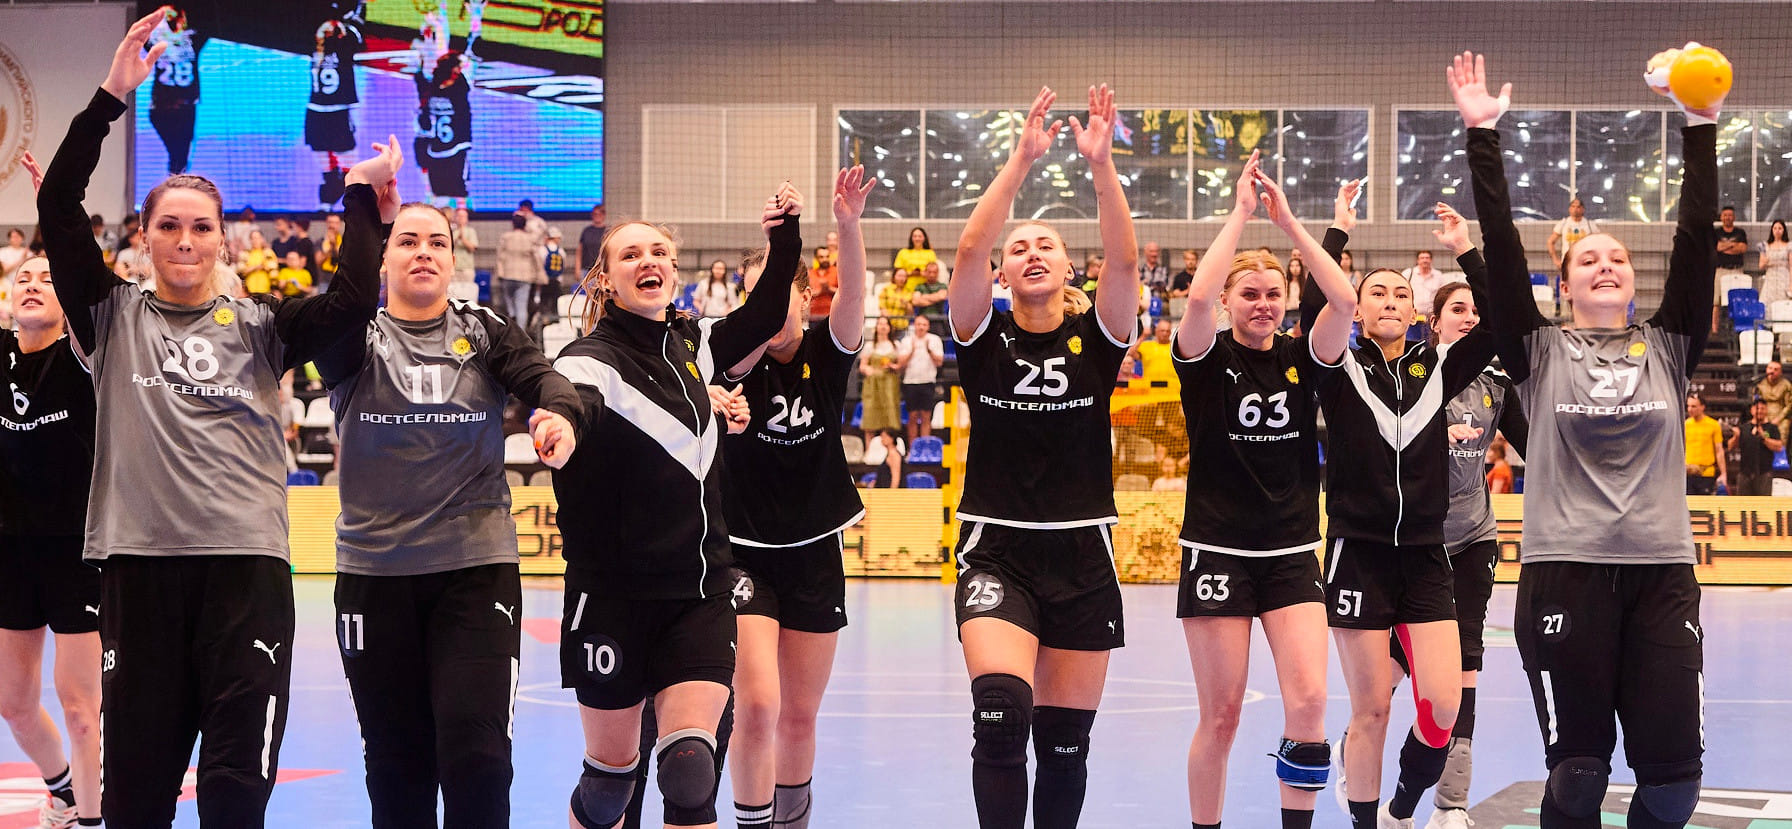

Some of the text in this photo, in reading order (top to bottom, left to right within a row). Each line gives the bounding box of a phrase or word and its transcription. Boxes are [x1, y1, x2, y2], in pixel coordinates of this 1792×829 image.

[156, 61, 195, 87] 28
[312, 68, 340, 94] 19
[405, 364, 443, 404] 11
[1014, 356, 1069, 397] 25
[1588, 366, 1639, 398] 27
[767, 395, 814, 434] 24
[979, 394, 1094, 412] РОСТСЕЛЬМАШ
[1238, 391, 1290, 428] 63
[1555, 400, 1669, 415] РОСТСЕЛЬМАШ
[360, 411, 487, 425] РОСТСЕЛЬМАШ
[733, 576, 752, 601] 4
[965, 580, 1002, 608] 25
[1196, 573, 1230, 601] 63
[1336, 589, 1363, 618] 51
[341, 613, 364, 651] 11
[1542, 613, 1565, 635] 27
[103, 649, 116, 673] 28
[583, 642, 616, 675] 10
[980, 711, 1004, 719] SELECT
[1054, 745, 1079, 754] SELECT
